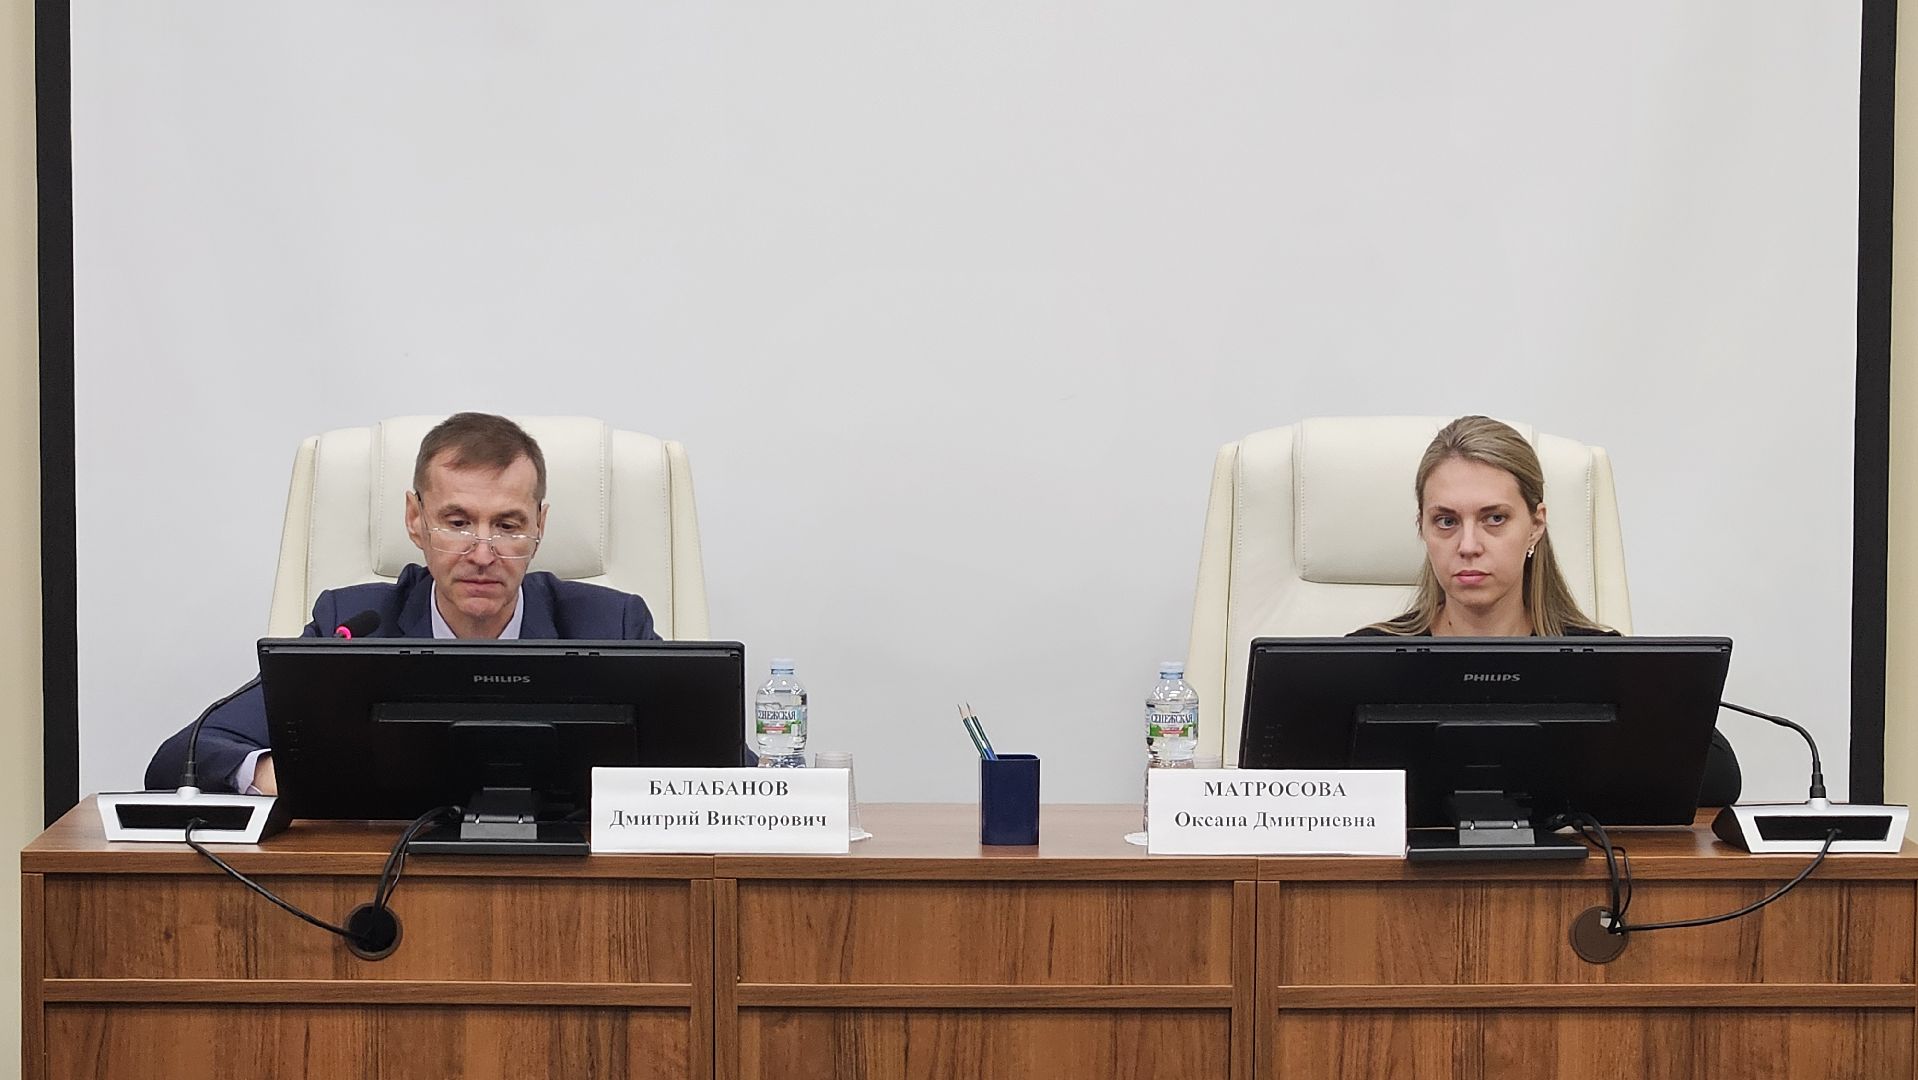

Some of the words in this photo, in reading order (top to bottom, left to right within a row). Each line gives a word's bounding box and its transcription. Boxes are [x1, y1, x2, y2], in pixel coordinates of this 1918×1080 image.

[473, 675, 531, 683] PHILIPS
[1463, 673, 1521, 682] PHILIPS
[649, 780, 789, 796] БАЛАБАНОВ
[1203, 781, 1347, 797] МАТРОСОВА
[609, 810, 700, 830] Дмитрий
[707, 810, 827, 830] Викторович
[1174, 811, 1248, 828] Оксана
[1253, 811, 1376, 831] Дмитриевна
